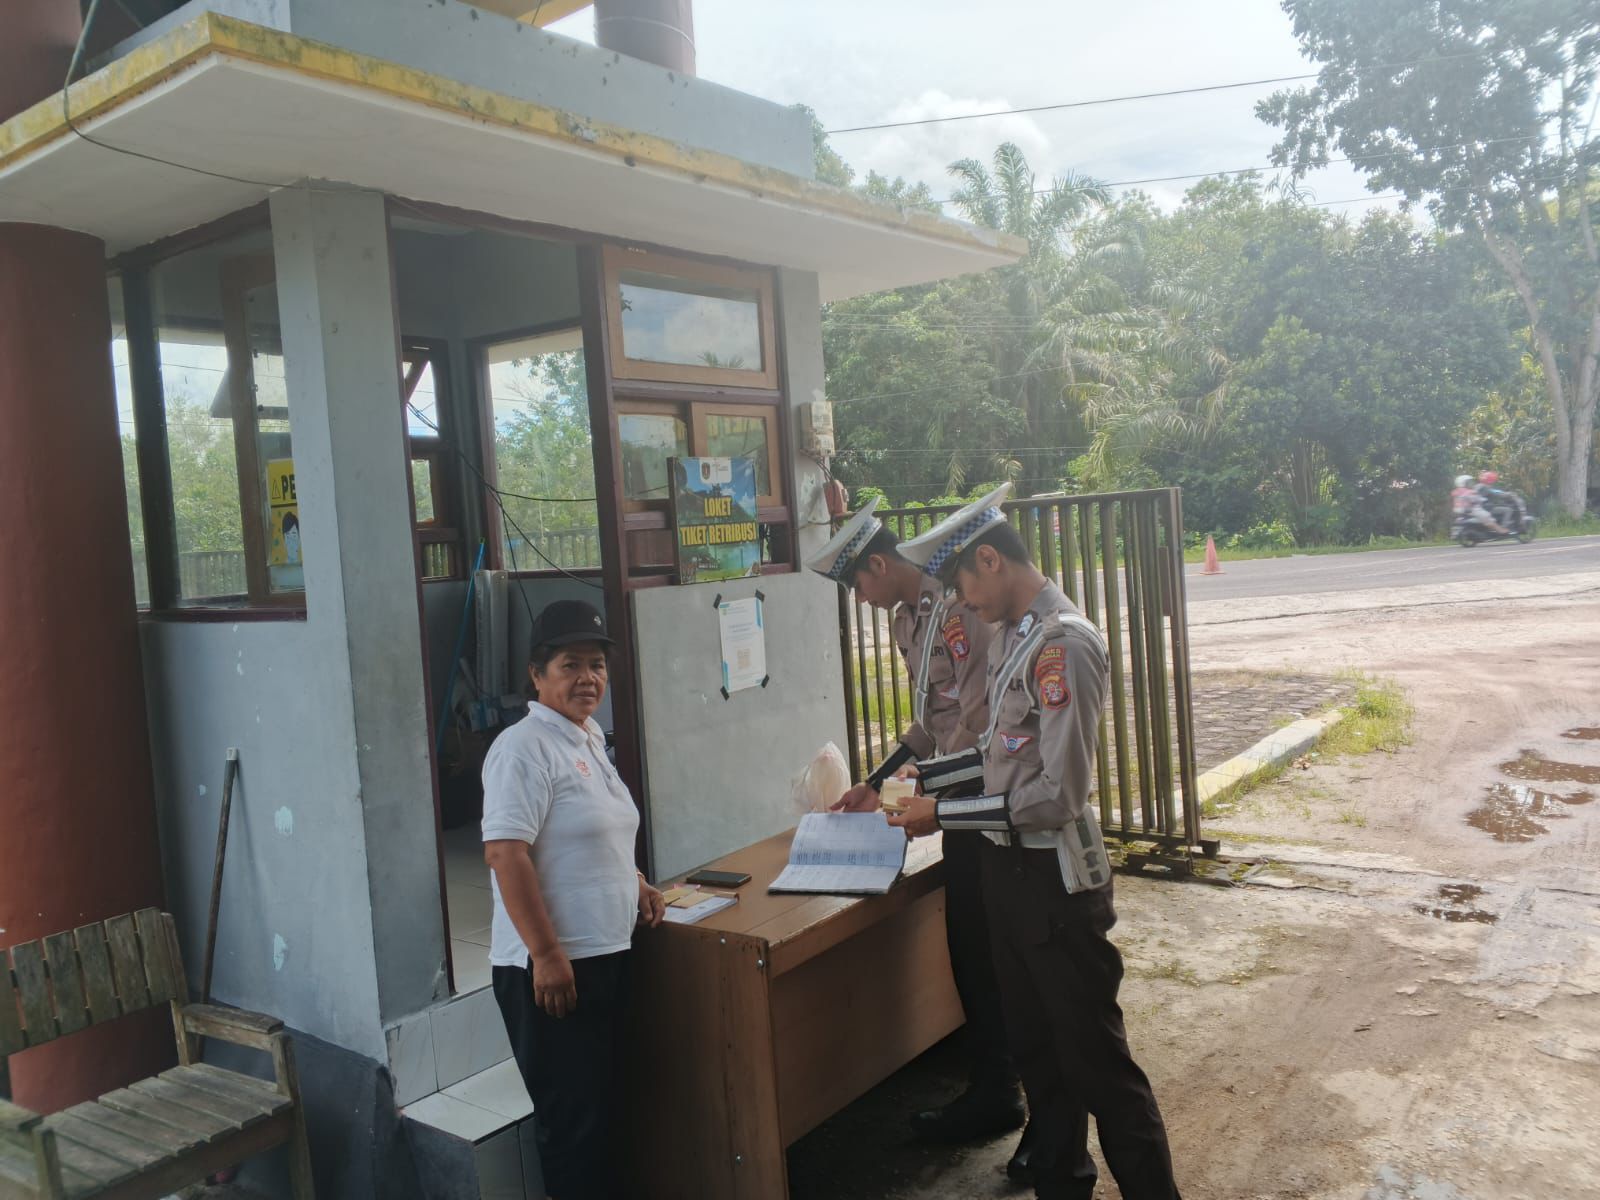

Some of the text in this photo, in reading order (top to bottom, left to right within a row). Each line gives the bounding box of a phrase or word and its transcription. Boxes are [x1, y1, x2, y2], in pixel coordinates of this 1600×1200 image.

[704, 497, 731, 516] LOKET
[680, 522, 756, 545] TIKET RETRIBUSI
